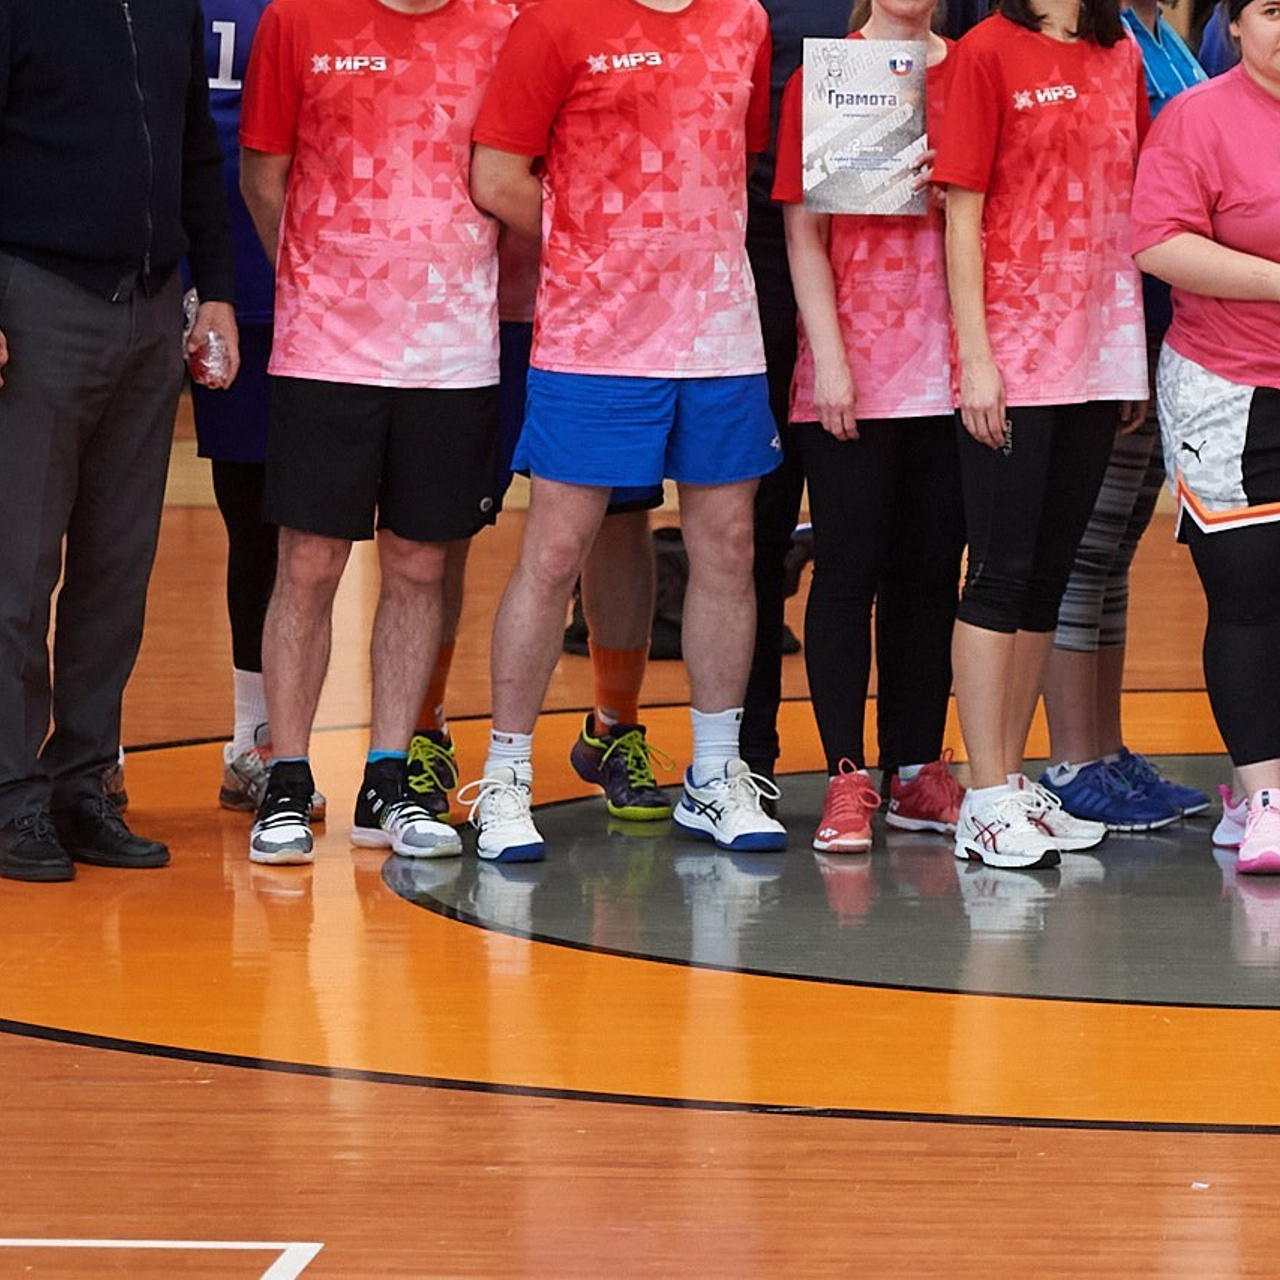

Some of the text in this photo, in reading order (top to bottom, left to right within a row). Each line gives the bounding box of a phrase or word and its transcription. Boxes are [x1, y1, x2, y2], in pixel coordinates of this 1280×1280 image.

[208, 20, 242, 90] 1
[334, 56, 387, 71] ИРЗ
[612, 51, 662, 68] ИРЗ
[827, 89, 898, 108] Грамота
[1035, 84, 1077, 102] ИРЗ
